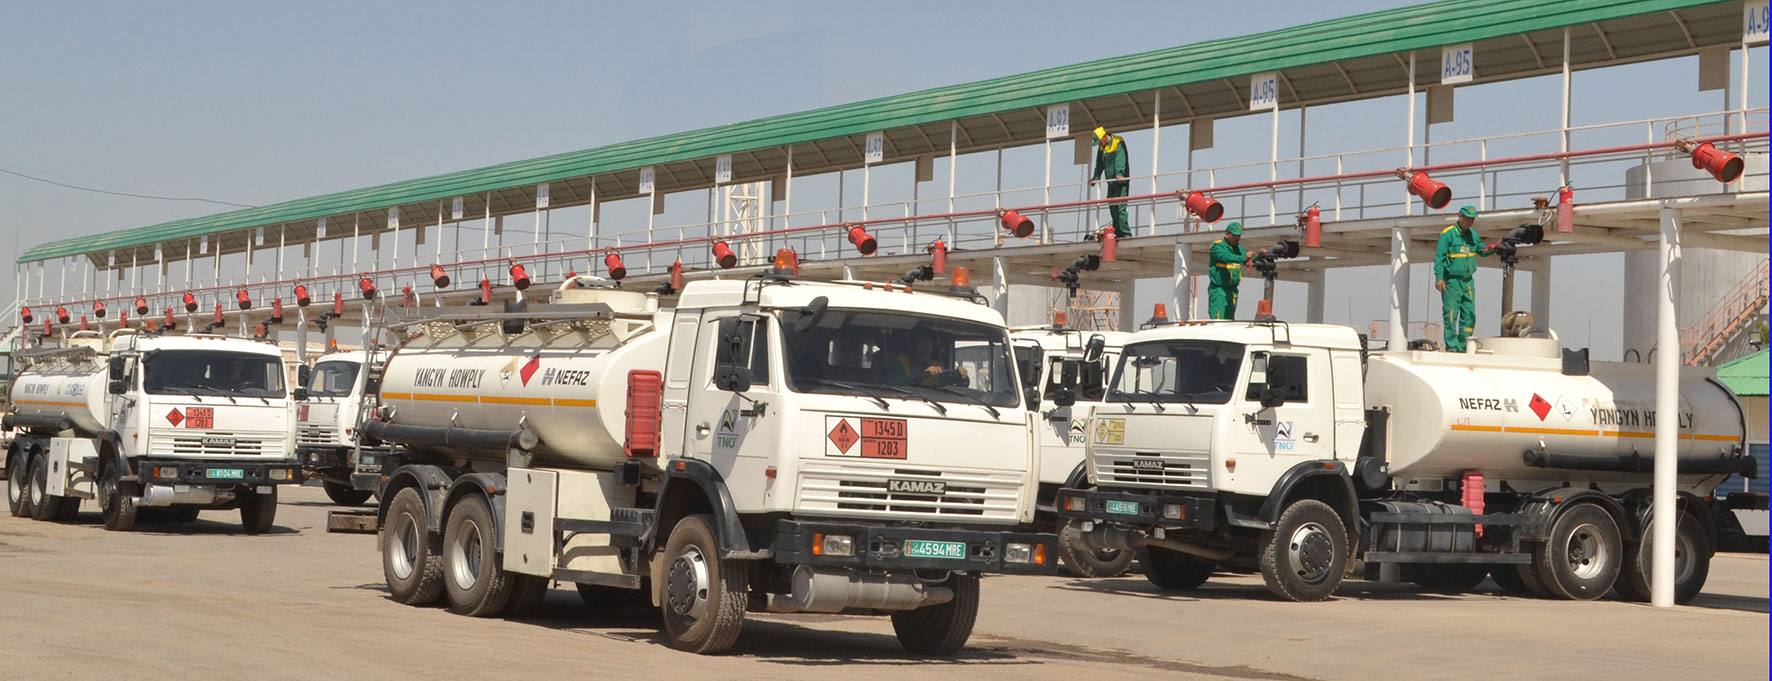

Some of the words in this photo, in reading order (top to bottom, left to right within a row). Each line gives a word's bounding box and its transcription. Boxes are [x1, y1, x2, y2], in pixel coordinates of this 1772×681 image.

[1444, 49, 1470, 78] A-95
[1252, 79, 1275, 106] A-95
[1048, 109, 1067, 133] A-92
[413, 367, 447, 388] YANGYN
[448, 368, 486, 389] HOWPLY
[554, 369, 590, 386] NEFAZ
[1459, 397, 1502, 411] NEFAZ
[1590, 408, 1640, 427] YANGYN
[874, 421, 896, 436] 1345
[897, 422, 903, 437] D
[877, 440, 899, 456] 1203
[1133, 460, 1163, 469] KAMAZ
[889, 480, 945, 493] KAMAZ
[919, 542, 945, 556] 4594
